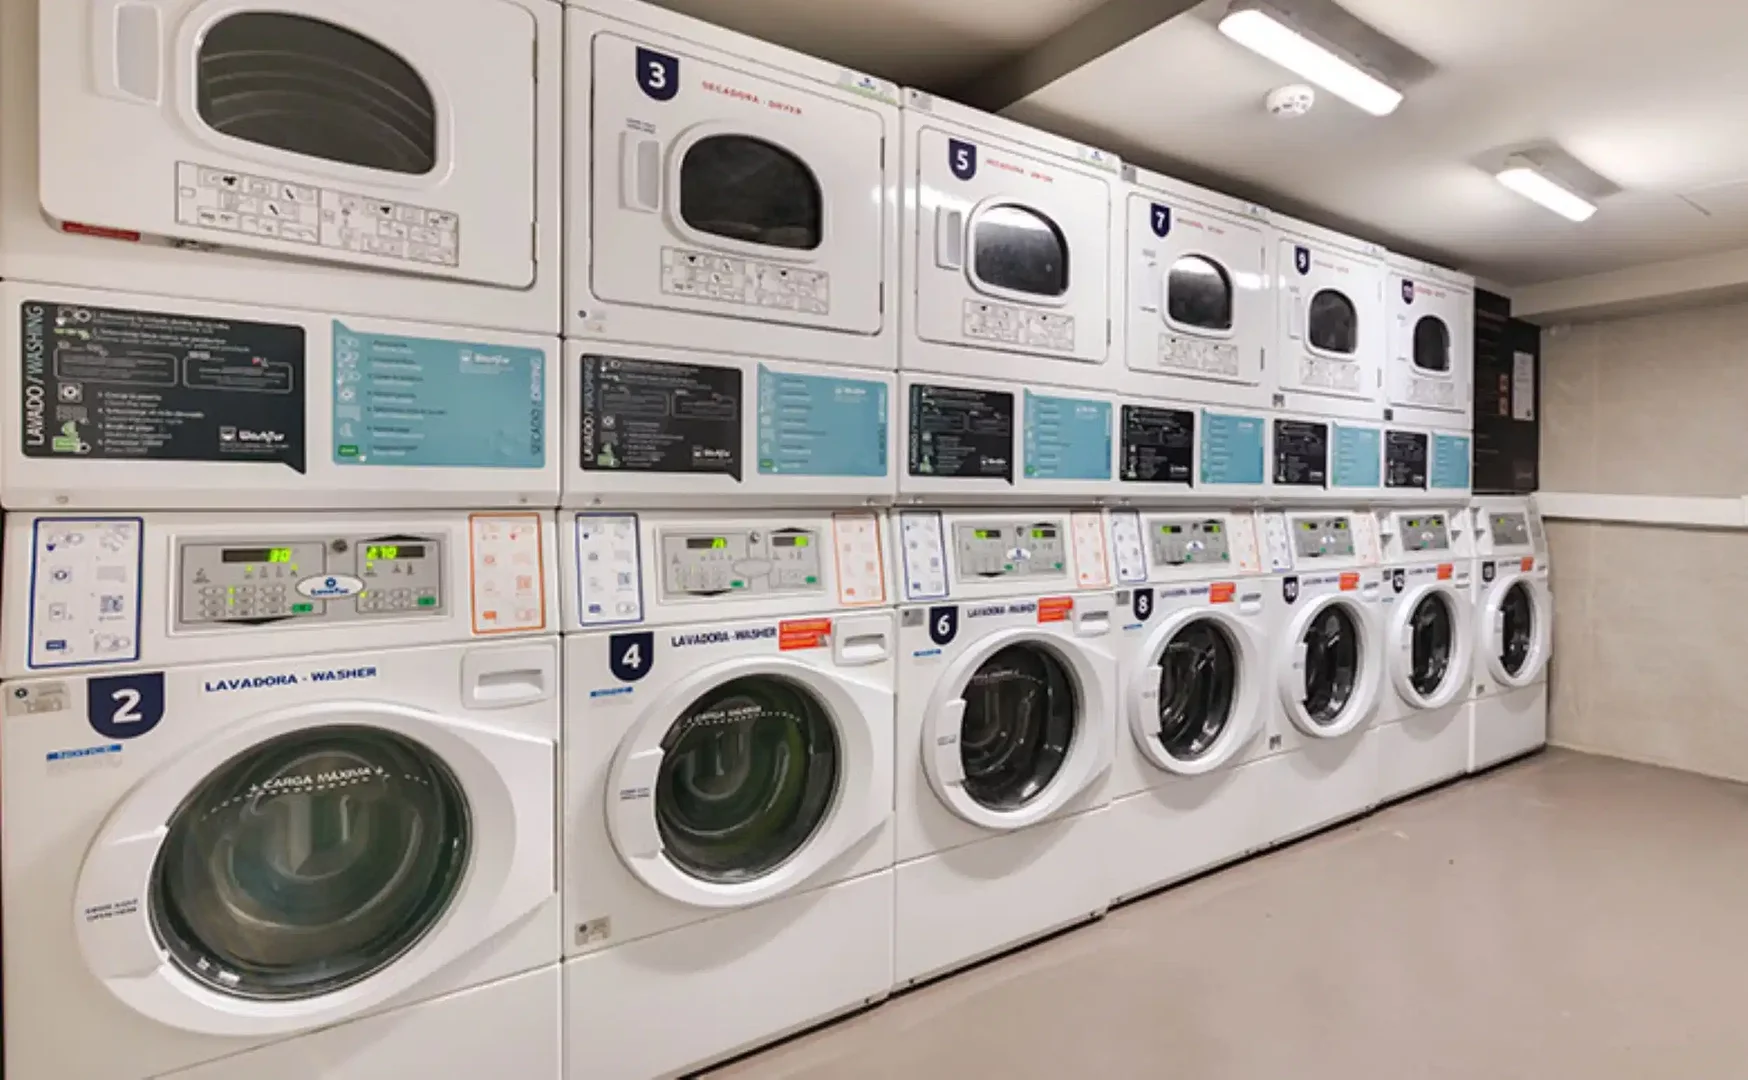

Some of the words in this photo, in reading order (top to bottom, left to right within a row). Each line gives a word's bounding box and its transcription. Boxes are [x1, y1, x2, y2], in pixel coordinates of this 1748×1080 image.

[649, 61, 666, 88] 3
[956, 149, 969, 171] 5
[1155, 211, 1166, 229] 7
[25, 305, 45, 375] WASHING
[25, 386, 45, 446] LAVADO
[1138, 594, 1150, 614] 8
[671, 631, 730, 648] LAVADORA
[735, 626, 777, 641] WASHER
[937, 615, 951, 636] 6
[621, 643, 641, 669] 4
[204, 673, 298, 693] LAVADORA
[310, 666, 377, 682] WASHER
[111, 688, 142, 724] 2
[262, 774, 314, 789] CARGA
